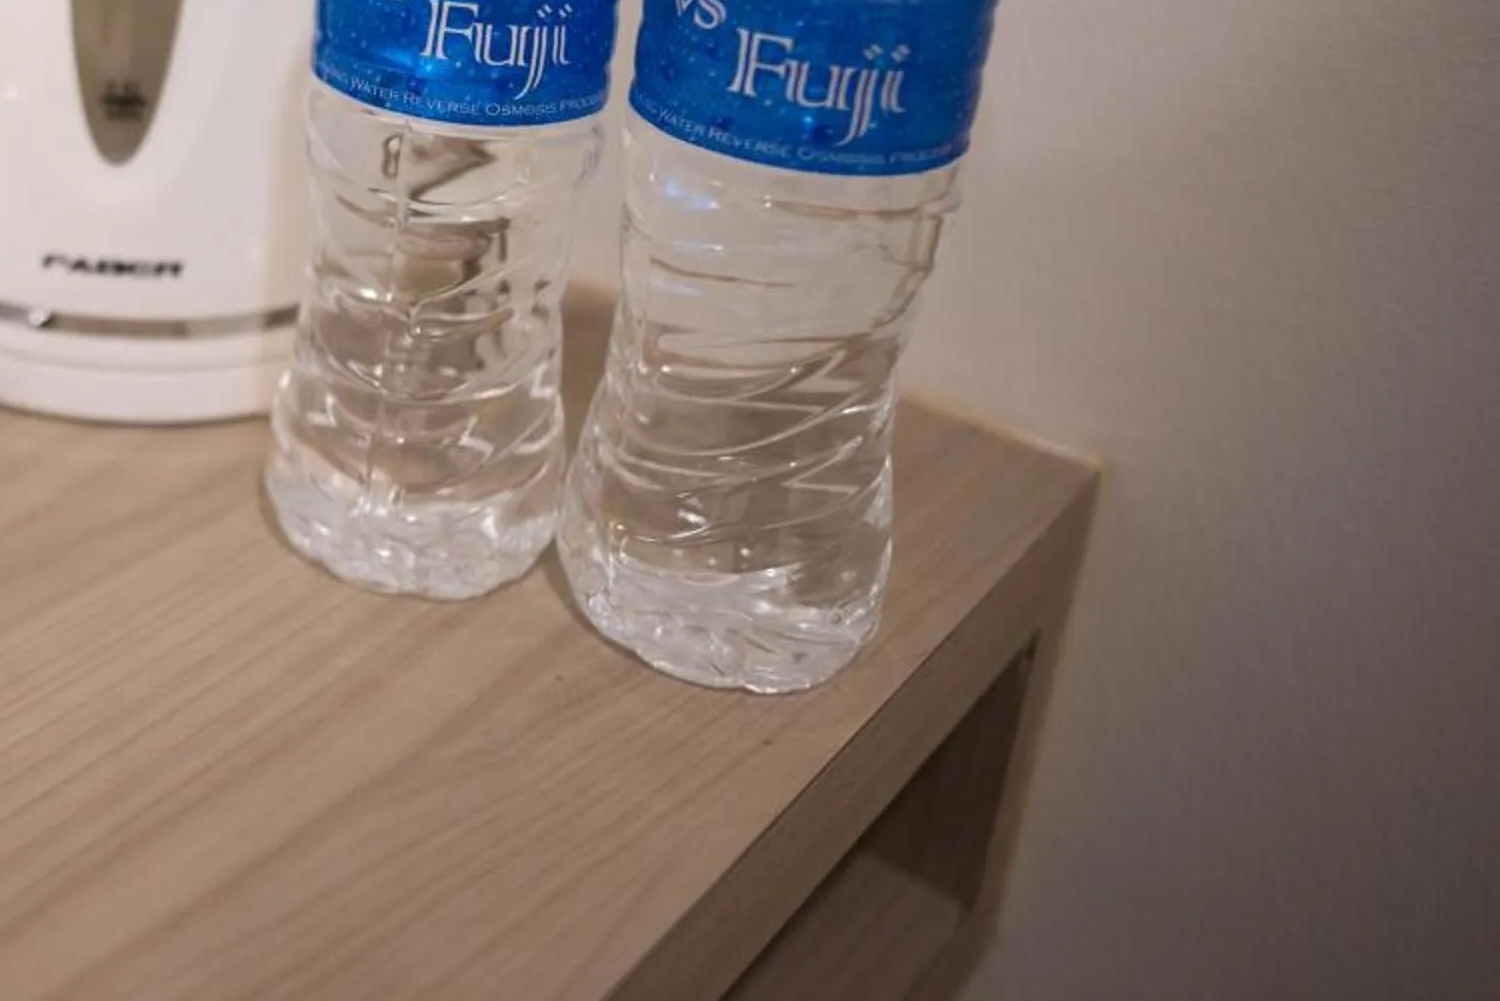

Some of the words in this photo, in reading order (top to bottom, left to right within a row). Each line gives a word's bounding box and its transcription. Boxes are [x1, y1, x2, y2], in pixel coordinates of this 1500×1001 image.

[350, 78, 400, 101] WATER
[485, 102, 557, 117] OSMOSIS
[727, 27, 913, 147] Fuji
